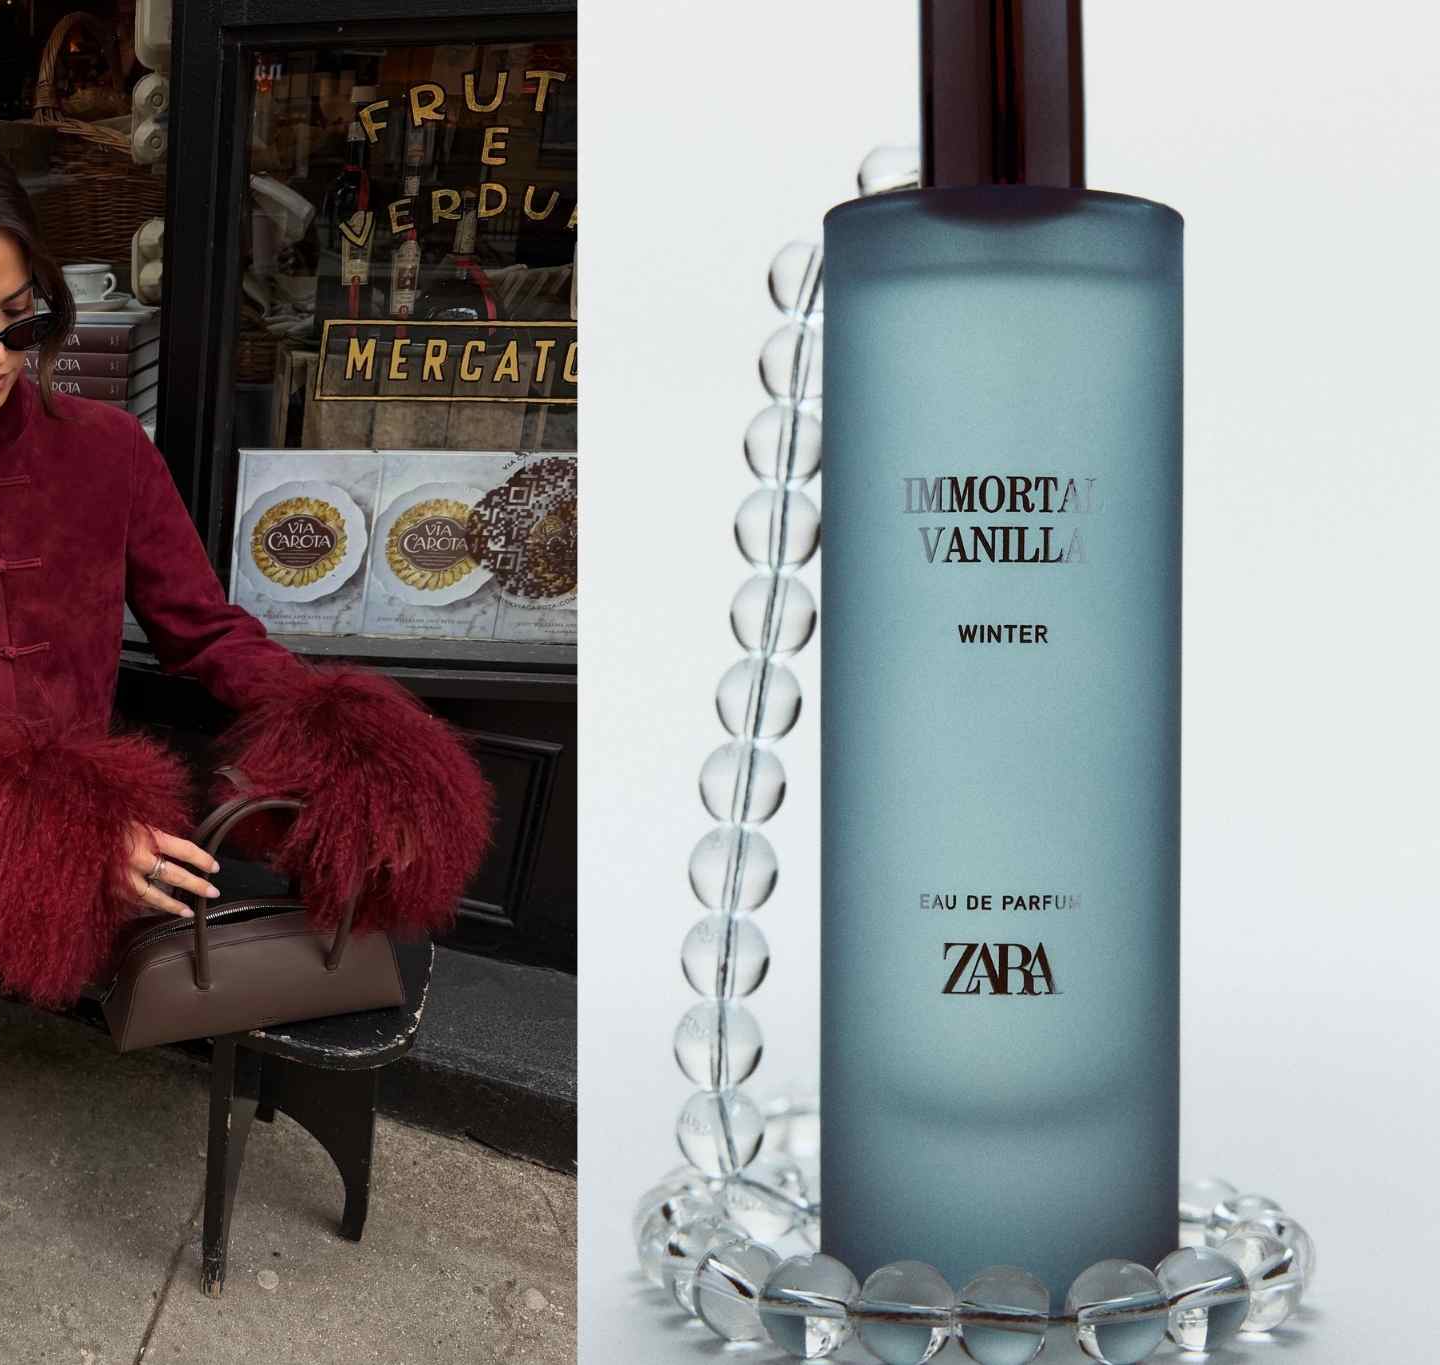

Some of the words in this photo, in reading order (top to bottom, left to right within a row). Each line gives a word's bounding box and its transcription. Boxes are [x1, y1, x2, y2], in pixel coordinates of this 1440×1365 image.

[480, 127, 510, 167] E
[338, 182, 577, 247] VERDU
[51, 381, 80, 394] ROTA
[288, 520, 314, 534] VIA
[425, 521, 452, 536] VIA
[268, 532, 331, 550] CAROTA
[404, 533, 468, 553] CAROTA
[917, 526, 1089, 564] VANILLA
[957, 624, 1049, 644] WINTER
[919, 894, 957, 911] EAU
[967, 895, 992, 911] DE
[941, 942, 1064, 996] ZARA
